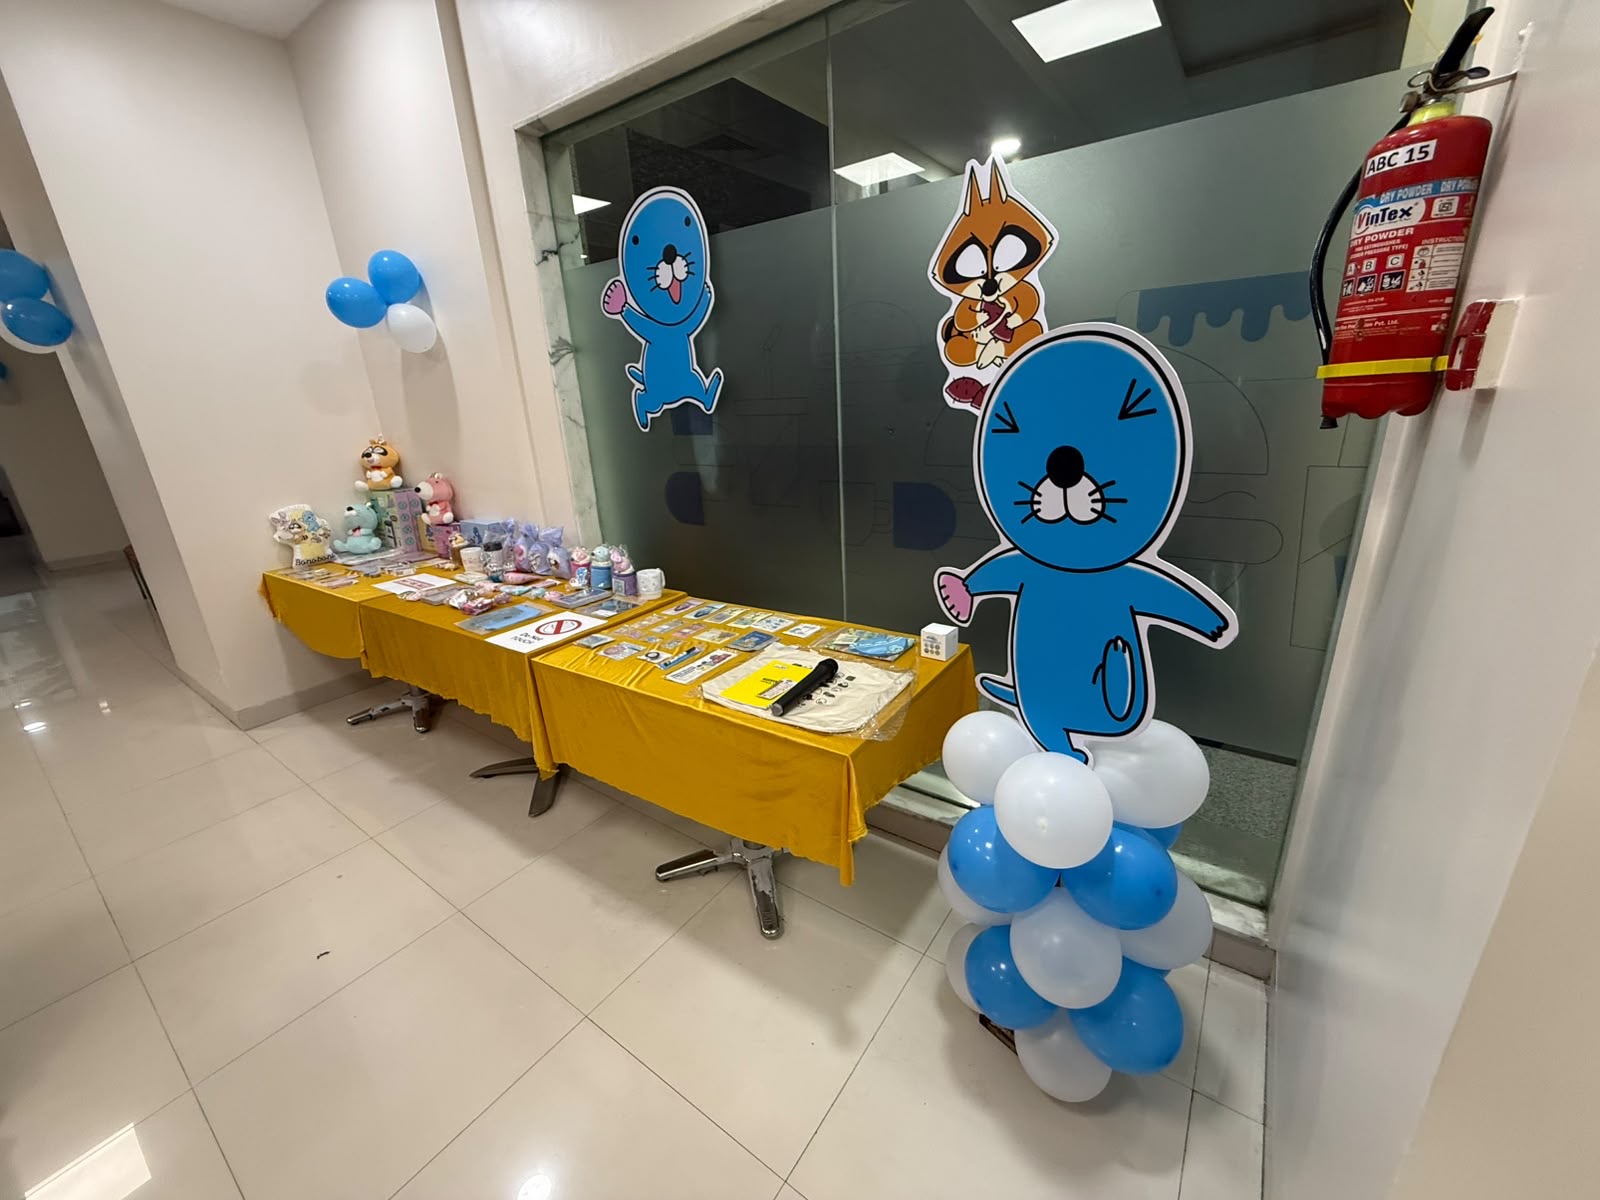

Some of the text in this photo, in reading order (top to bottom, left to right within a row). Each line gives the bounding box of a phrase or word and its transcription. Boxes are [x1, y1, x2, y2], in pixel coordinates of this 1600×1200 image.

[1367, 144, 1430, 175] ABC 15
[1380, 183, 1433, 204] DRY POWDER
[1364, 227, 1414, 243] POWDER
[1390, 256, 1400, 266] C
